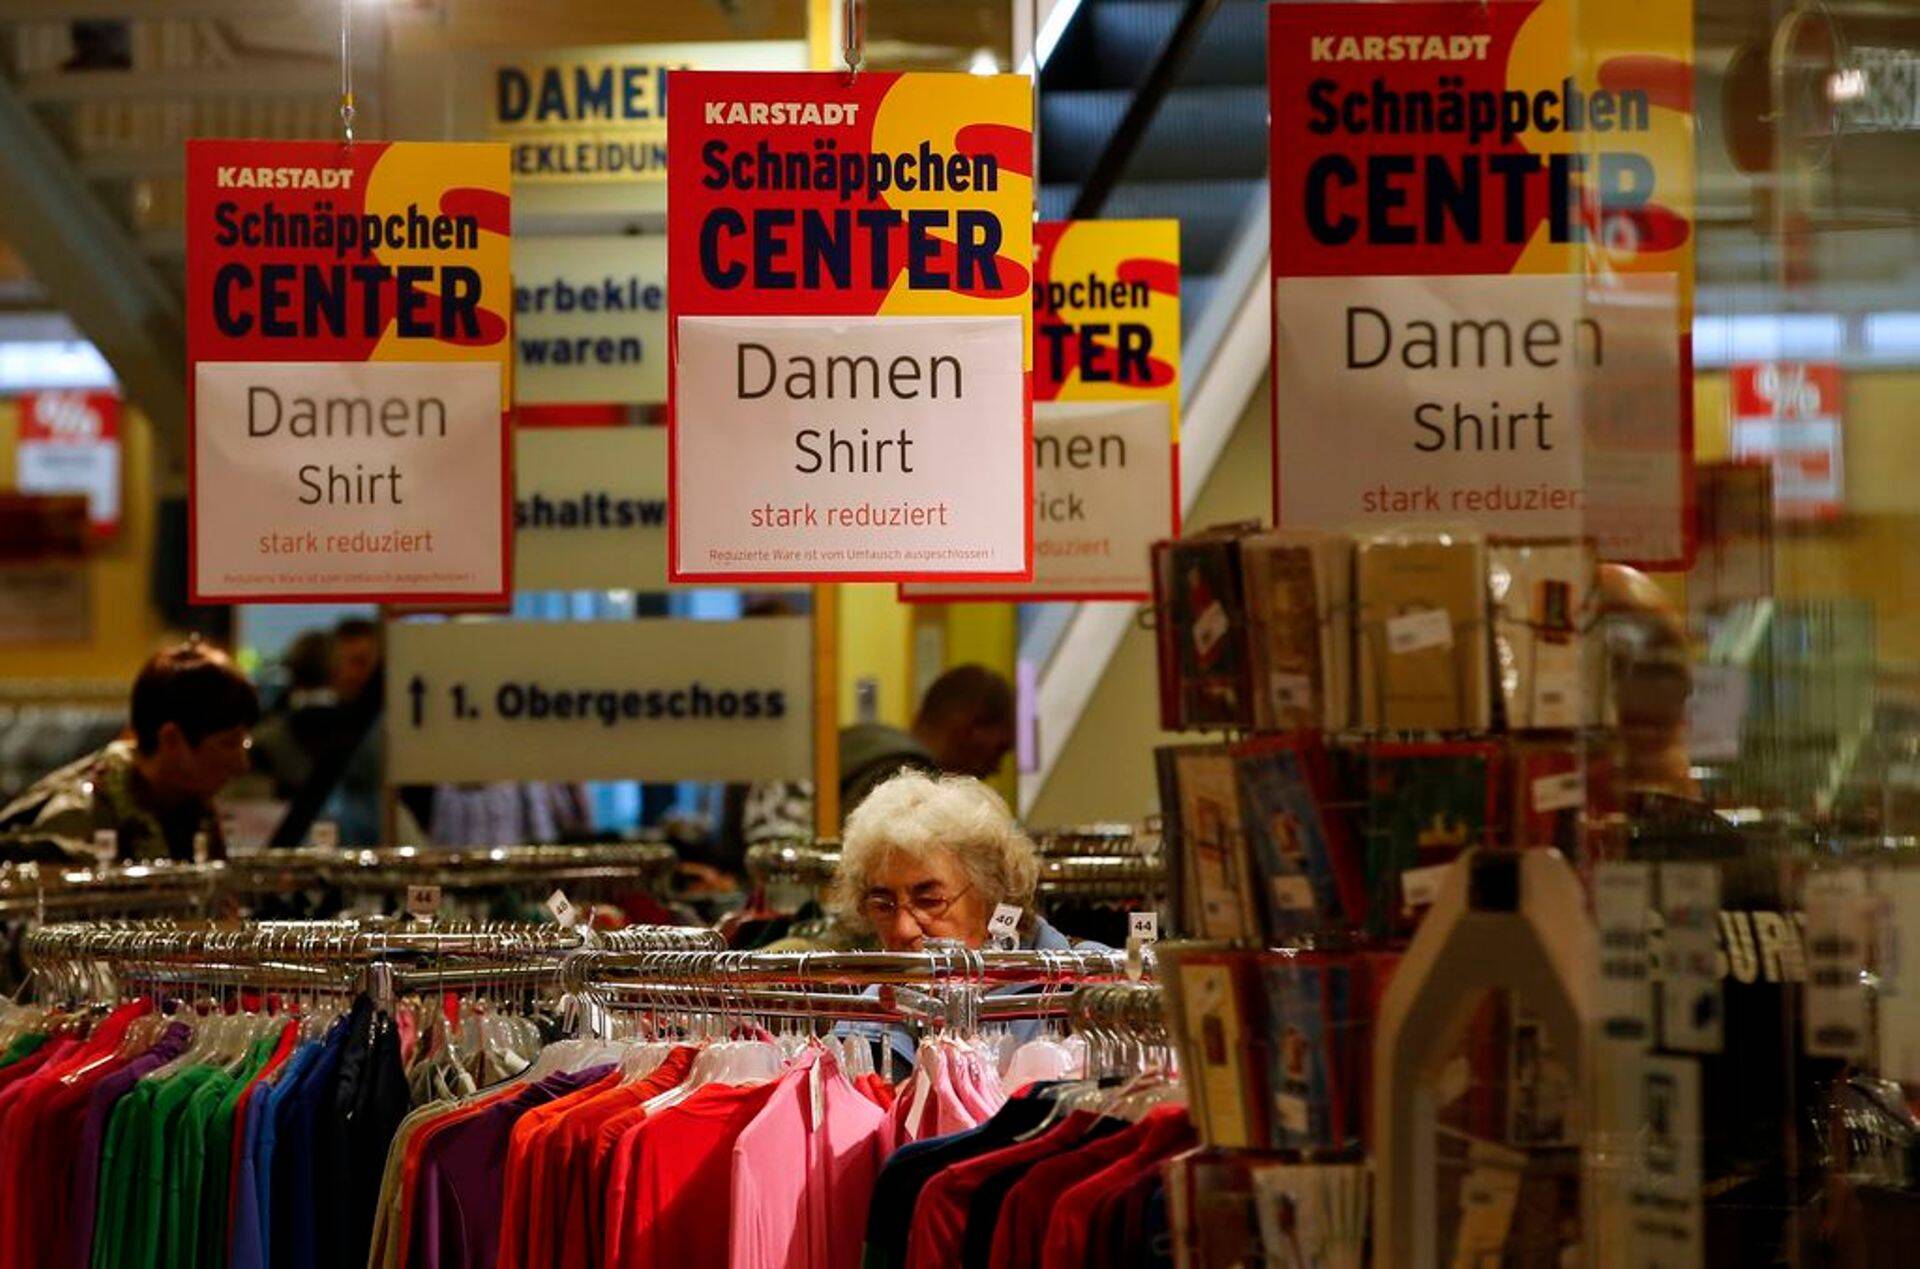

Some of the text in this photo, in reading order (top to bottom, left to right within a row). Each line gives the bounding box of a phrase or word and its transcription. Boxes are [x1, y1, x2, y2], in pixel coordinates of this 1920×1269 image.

[1311, 35, 1492, 62] KARSTADT
[704, 102, 860, 126] KARSTADT
[1306, 75, 1649, 145] Schnäppchen
[217, 167, 354, 190] KARSTADT
[512, 144, 667, 174] EKLEIDUN
[702, 138, 998, 201] Schnäppchen
[1304, 151, 1656, 245] CENTER
[214, 202, 479, 258] Schnäppchen
[700, 207, 1003, 291] CENTER
[213, 263, 482, 338] CENTER
[521, 336, 643, 365] waren
[1040, 323, 1153, 383] TER
[1346, 306, 1604, 369] Damen
[737, 342, 962, 400] Damen
[247, 385, 447, 438] Damen
[1413, 402, 1553, 452] Shirt
[795, 428, 913, 474] Shirt
[298, 464, 403, 505] Shirt
[1363, 484, 1584, 513] stark reduzier
[751, 502, 948, 528] stark reduziert
[1034, 492, 1085, 522] ick
[259, 530, 434, 554] stark reduziert
[709, 550, 769, 562] Reduzierte
[772, 550, 801, 562] Ware
[821, 551, 845, 561] vom
[846, 549, 901, 561] Umtausch
[1035, 539, 1110, 556] duziert
[450, 681, 786, 726] 1. Obergeschoss
[995, 914, 1014, 926] 40
[1134, 920, 1152, 932] 44
